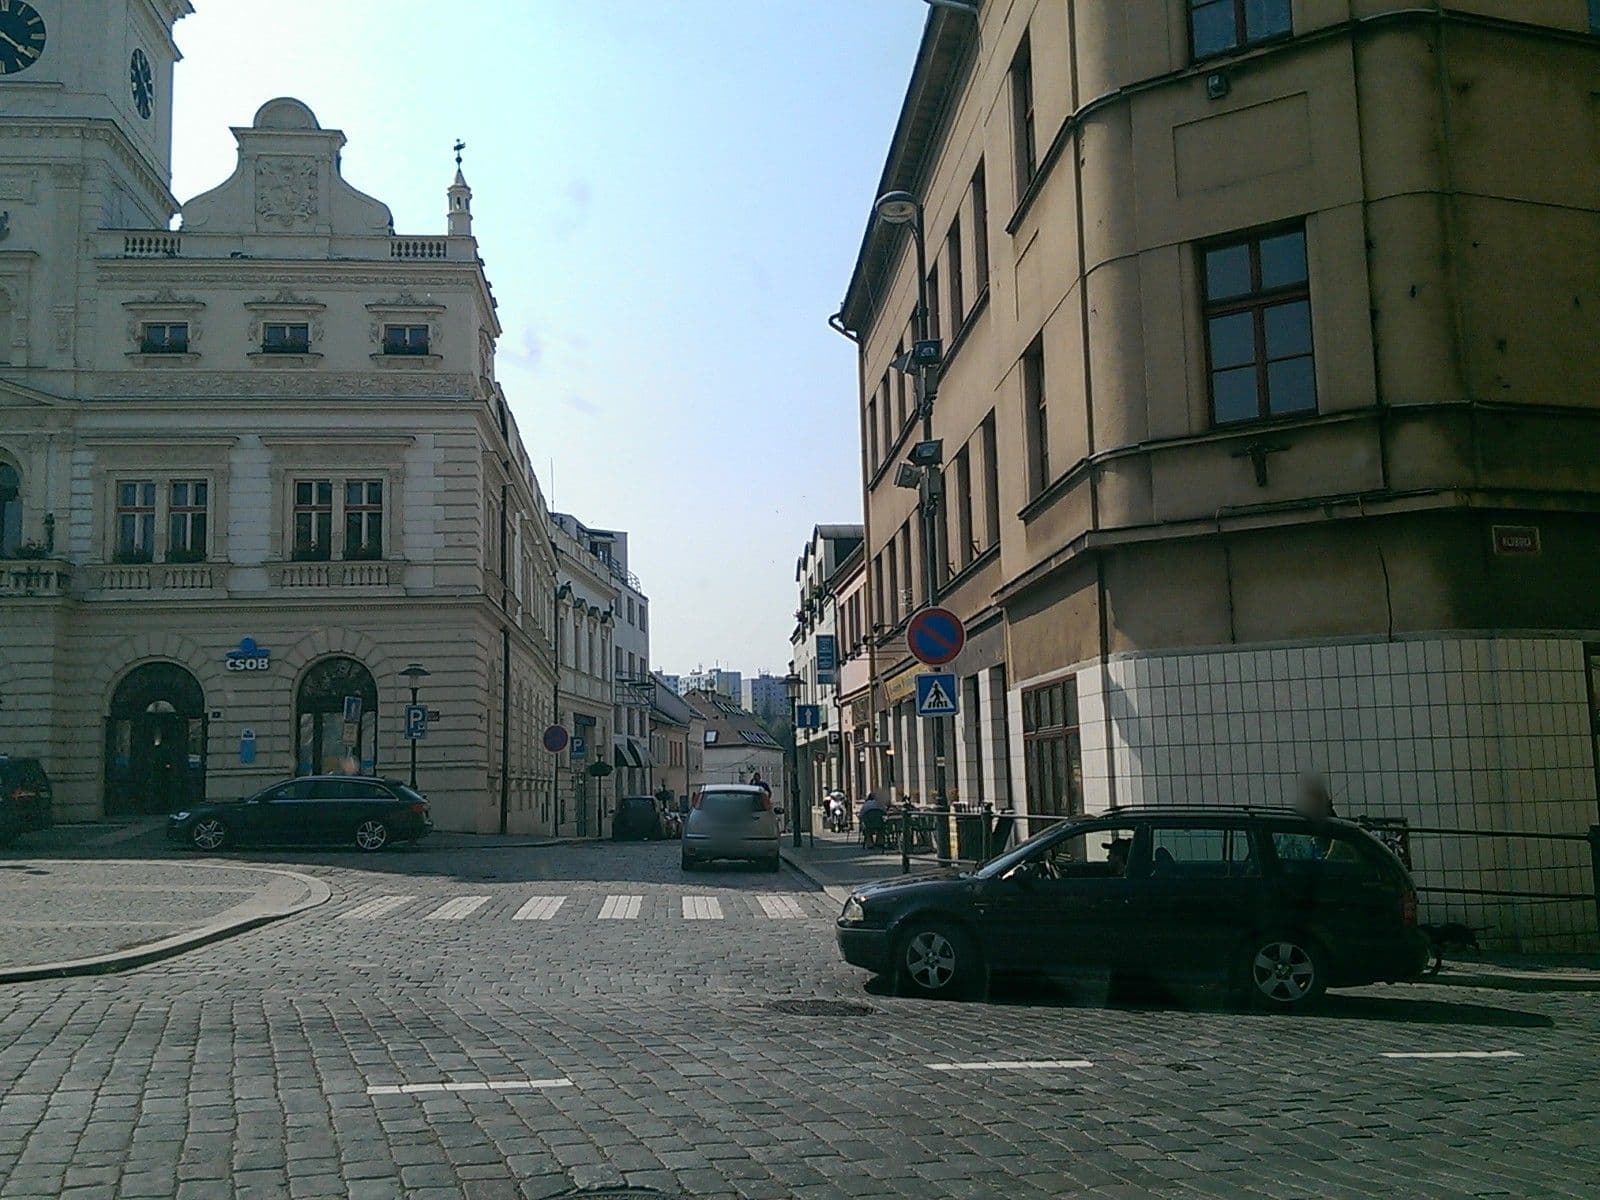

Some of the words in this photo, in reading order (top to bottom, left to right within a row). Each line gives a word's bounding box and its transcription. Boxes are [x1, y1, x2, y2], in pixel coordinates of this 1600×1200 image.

[410, 709, 423, 729] P
[831, 732, 840, 743] P
[573, 738, 583, 752] P
